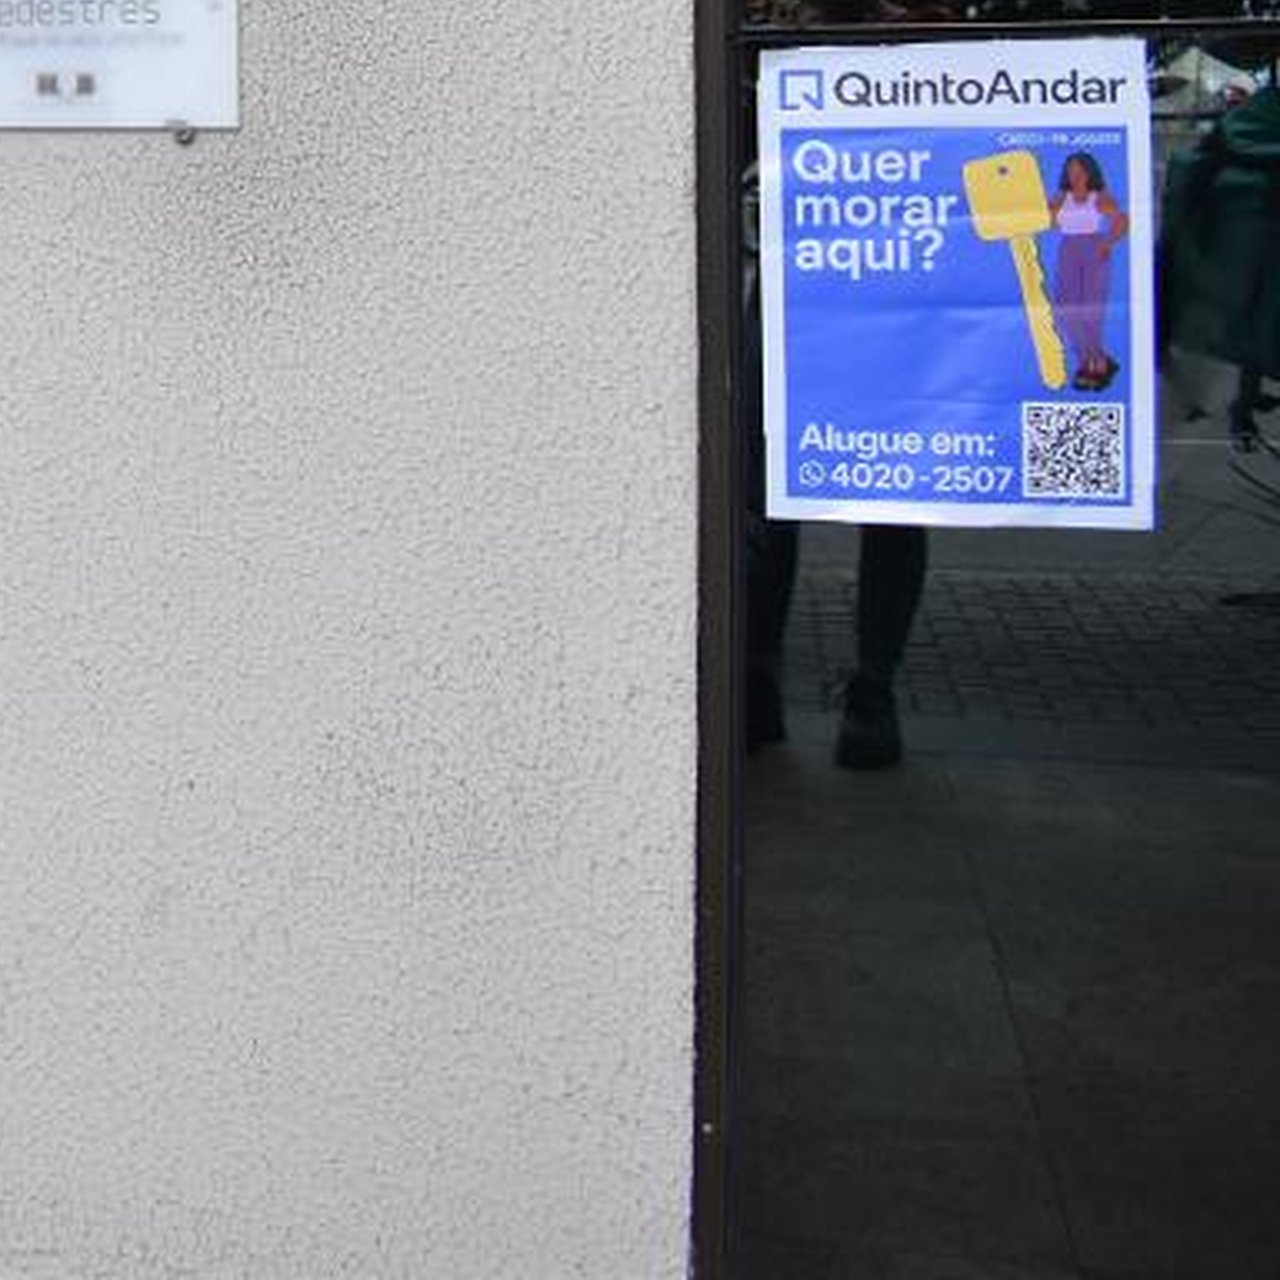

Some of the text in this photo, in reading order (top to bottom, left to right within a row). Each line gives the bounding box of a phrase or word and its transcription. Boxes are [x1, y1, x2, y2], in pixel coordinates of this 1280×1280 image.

[833, 69, 1127, 107] QuintoAndar
[792, 139, 931, 184] Quer
[795, 192, 958, 227] morar
[795, 228, 945, 281] aqui?
[799, 422, 996, 461] Alugue em:
[831, 462, 1015, 494] 4020-2507
